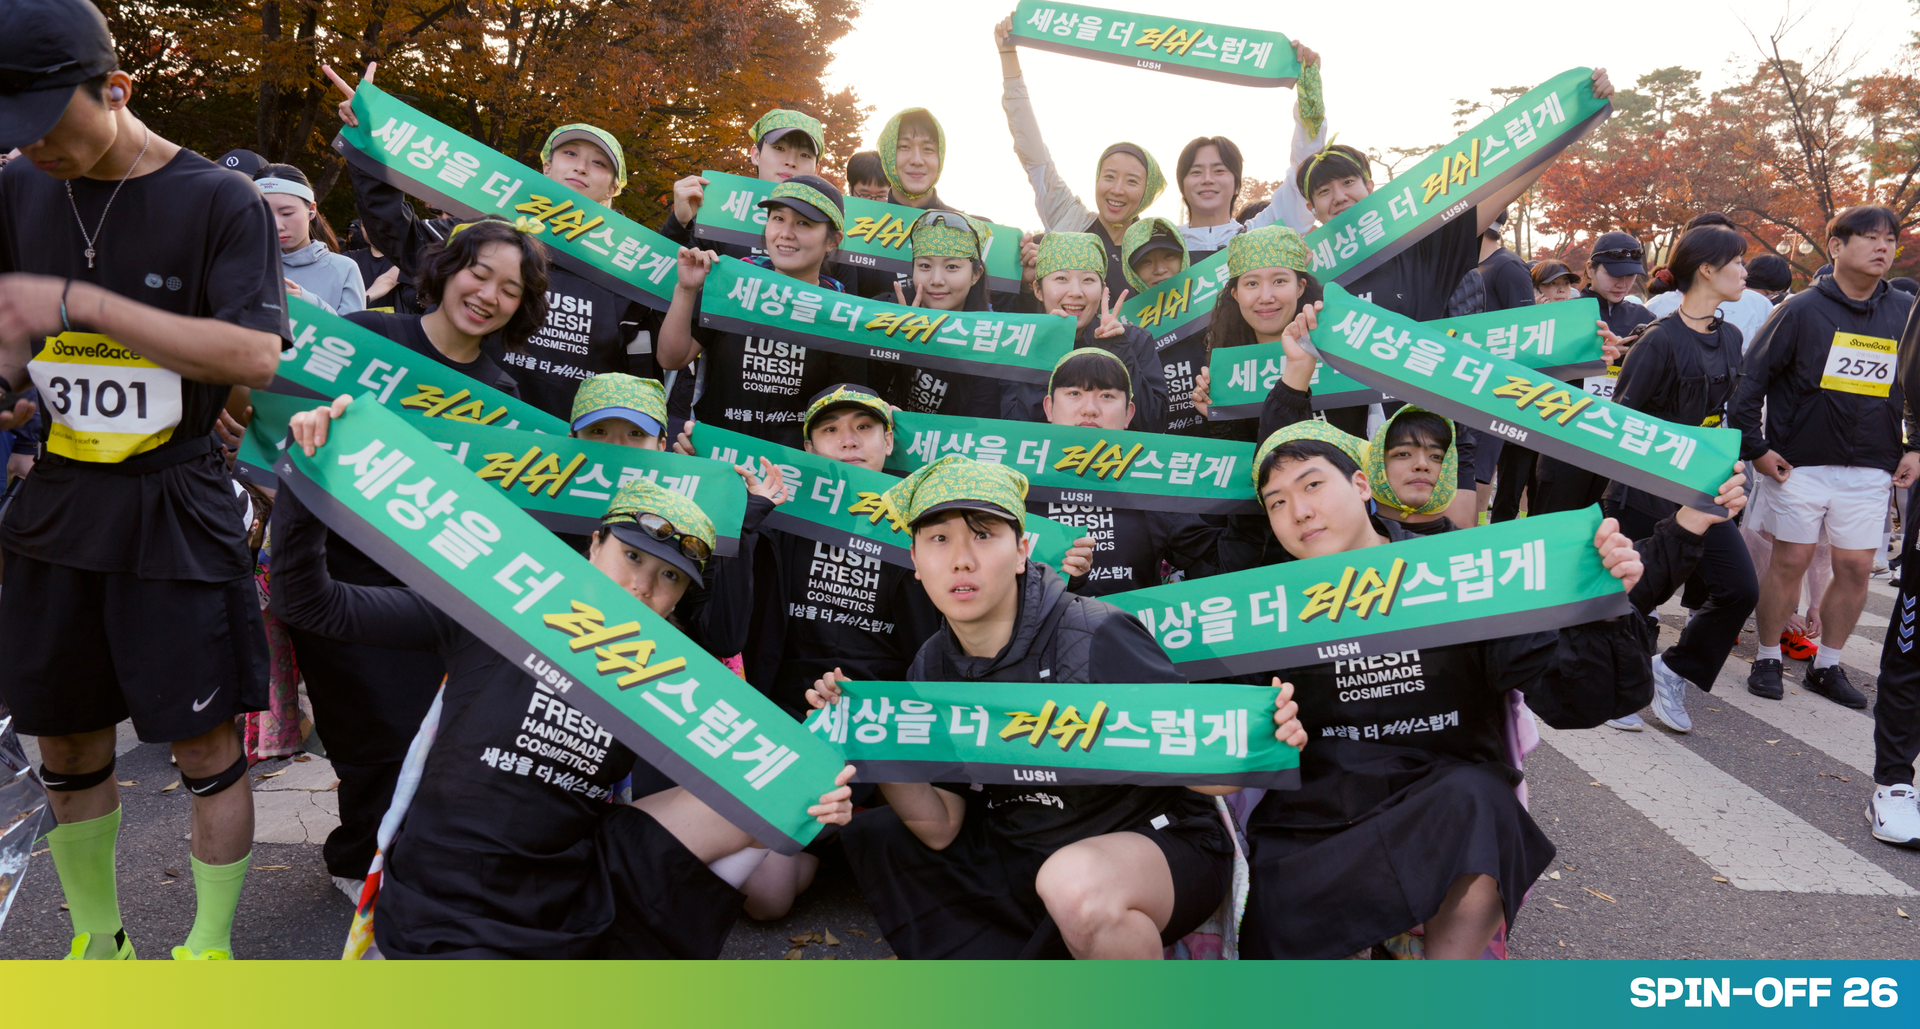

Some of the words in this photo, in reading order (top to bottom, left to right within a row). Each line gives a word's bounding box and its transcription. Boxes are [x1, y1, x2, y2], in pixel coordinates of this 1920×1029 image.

[1027, 8, 1103, 42] 세상을
[1108, 21, 1136, 47] 더
[1135, 24, 1274, 69] 러쉬스럽게
[1136, 59, 1162, 71] LUSH
[1311, 209, 1386, 273] 세상을
[1387, 186, 1418, 221] 더
[1420, 91, 1566, 204] 러쉬스럽게
[371, 117, 481, 189] 세상을
[480, 171, 524, 208] 더
[514, 193, 678, 285] 러쉬스럽게
[1440, 200, 1469, 222] LUSH
[849, 254, 876, 266] LUSH
[545, 291, 593, 317] USH
[1136, 263, 1229, 328] 러쉬스
[545, 310, 592, 334] RESH
[727, 276, 823, 325] 세상을
[829, 300, 864, 332] 더
[864, 311, 1037, 357] 러쉬스럽게
[527, 335, 589, 355] COSMETICS
[538, 327, 590, 345] ANDMADE
[744, 336, 806, 360] LUSH
[1849, 338, 1891, 351] SaveRace
[52, 339, 141, 360] SaveRace
[279, 318, 356, 383] 상을
[357, 358, 409, 405] 더
[870, 348, 900, 361] LUSH
[503, 352, 538, 371] 세상을
[539, 360, 552, 374] 더
[551, 364, 599, 380] 러쉬스럽
[742, 354, 804, 377] FRESH
[1163, 361, 1192, 380] SH
[1836, 357, 1889, 380] 2576
[742, 371, 802, 387] HANDMADE
[743, 382, 800, 396] COSMETICS
[912, 368, 949, 397] SH
[1332, 310, 1446, 377] 세상을
[1452, 355, 1494, 395] 더
[1492, 375, 1697, 471] 러쉬스럽게
[49, 376, 147, 419] 3101
[1169, 391, 1193, 403] MADE
[1169, 401, 1195, 412] ETICS
[724, 408, 753, 422] 세상을
[755, 411, 764, 423] 더
[765, 410, 806, 422] 러쉬스럽
[1168, 415, 1203, 430] 러쉬스럽
[1489, 420, 1528, 443] LUSH
[1016, 439, 1051, 474] 더
[1053, 438, 1237, 488] 러쉬스럽게
[810, 475, 846, 515] 더
[1060, 491, 1093, 503] LUSH
[1048, 514, 1114, 529] RESH
[848, 537, 882, 556] LUSH
[809, 559, 880, 590] FRESH
[1088, 566, 1133, 580] 쉬스럽게
[808, 578, 877, 602] HANDMADE
[1249, 584, 1288, 633] 더
[1298, 539, 1547, 621] 러쉬스럽게
[806, 590, 875, 614] COSMETICS
[338, 439, 502, 570] 세상을
[493, 551, 565, 614] 더
[543, 599, 800, 790] 러쉬스럽게
[820, 608, 834, 623] 더
[833, 612, 895, 635] 러쉬스럽게
[1317, 641, 1361, 659] LUSH
[523, 653, 573, 694] LUSH
[1336, 664, 1423, 689] HANDMADE
[1339, 680, 1426, 702] COSMETICS
[527, 691, 613, 748] FRESH
[808, 696, 937, 745] 세상을
[949, 704, 990, 747] 더
[999, 699, 1249, 758] 러쉬스럽게
[1321, 725, 1360, 741] 세상을
[1364, 724, 1379, 740] 더
[1381, 710, 1459, 737] 러쉬스럽게
[521, 716, 607, 763] HANDMADE
[480, 747, 534, 776] 세상을
[535, 764, 554, 784] 더
[515, 734, 599, 776] COSMETICS
[1013, 769, 1058, 782] LUSH
